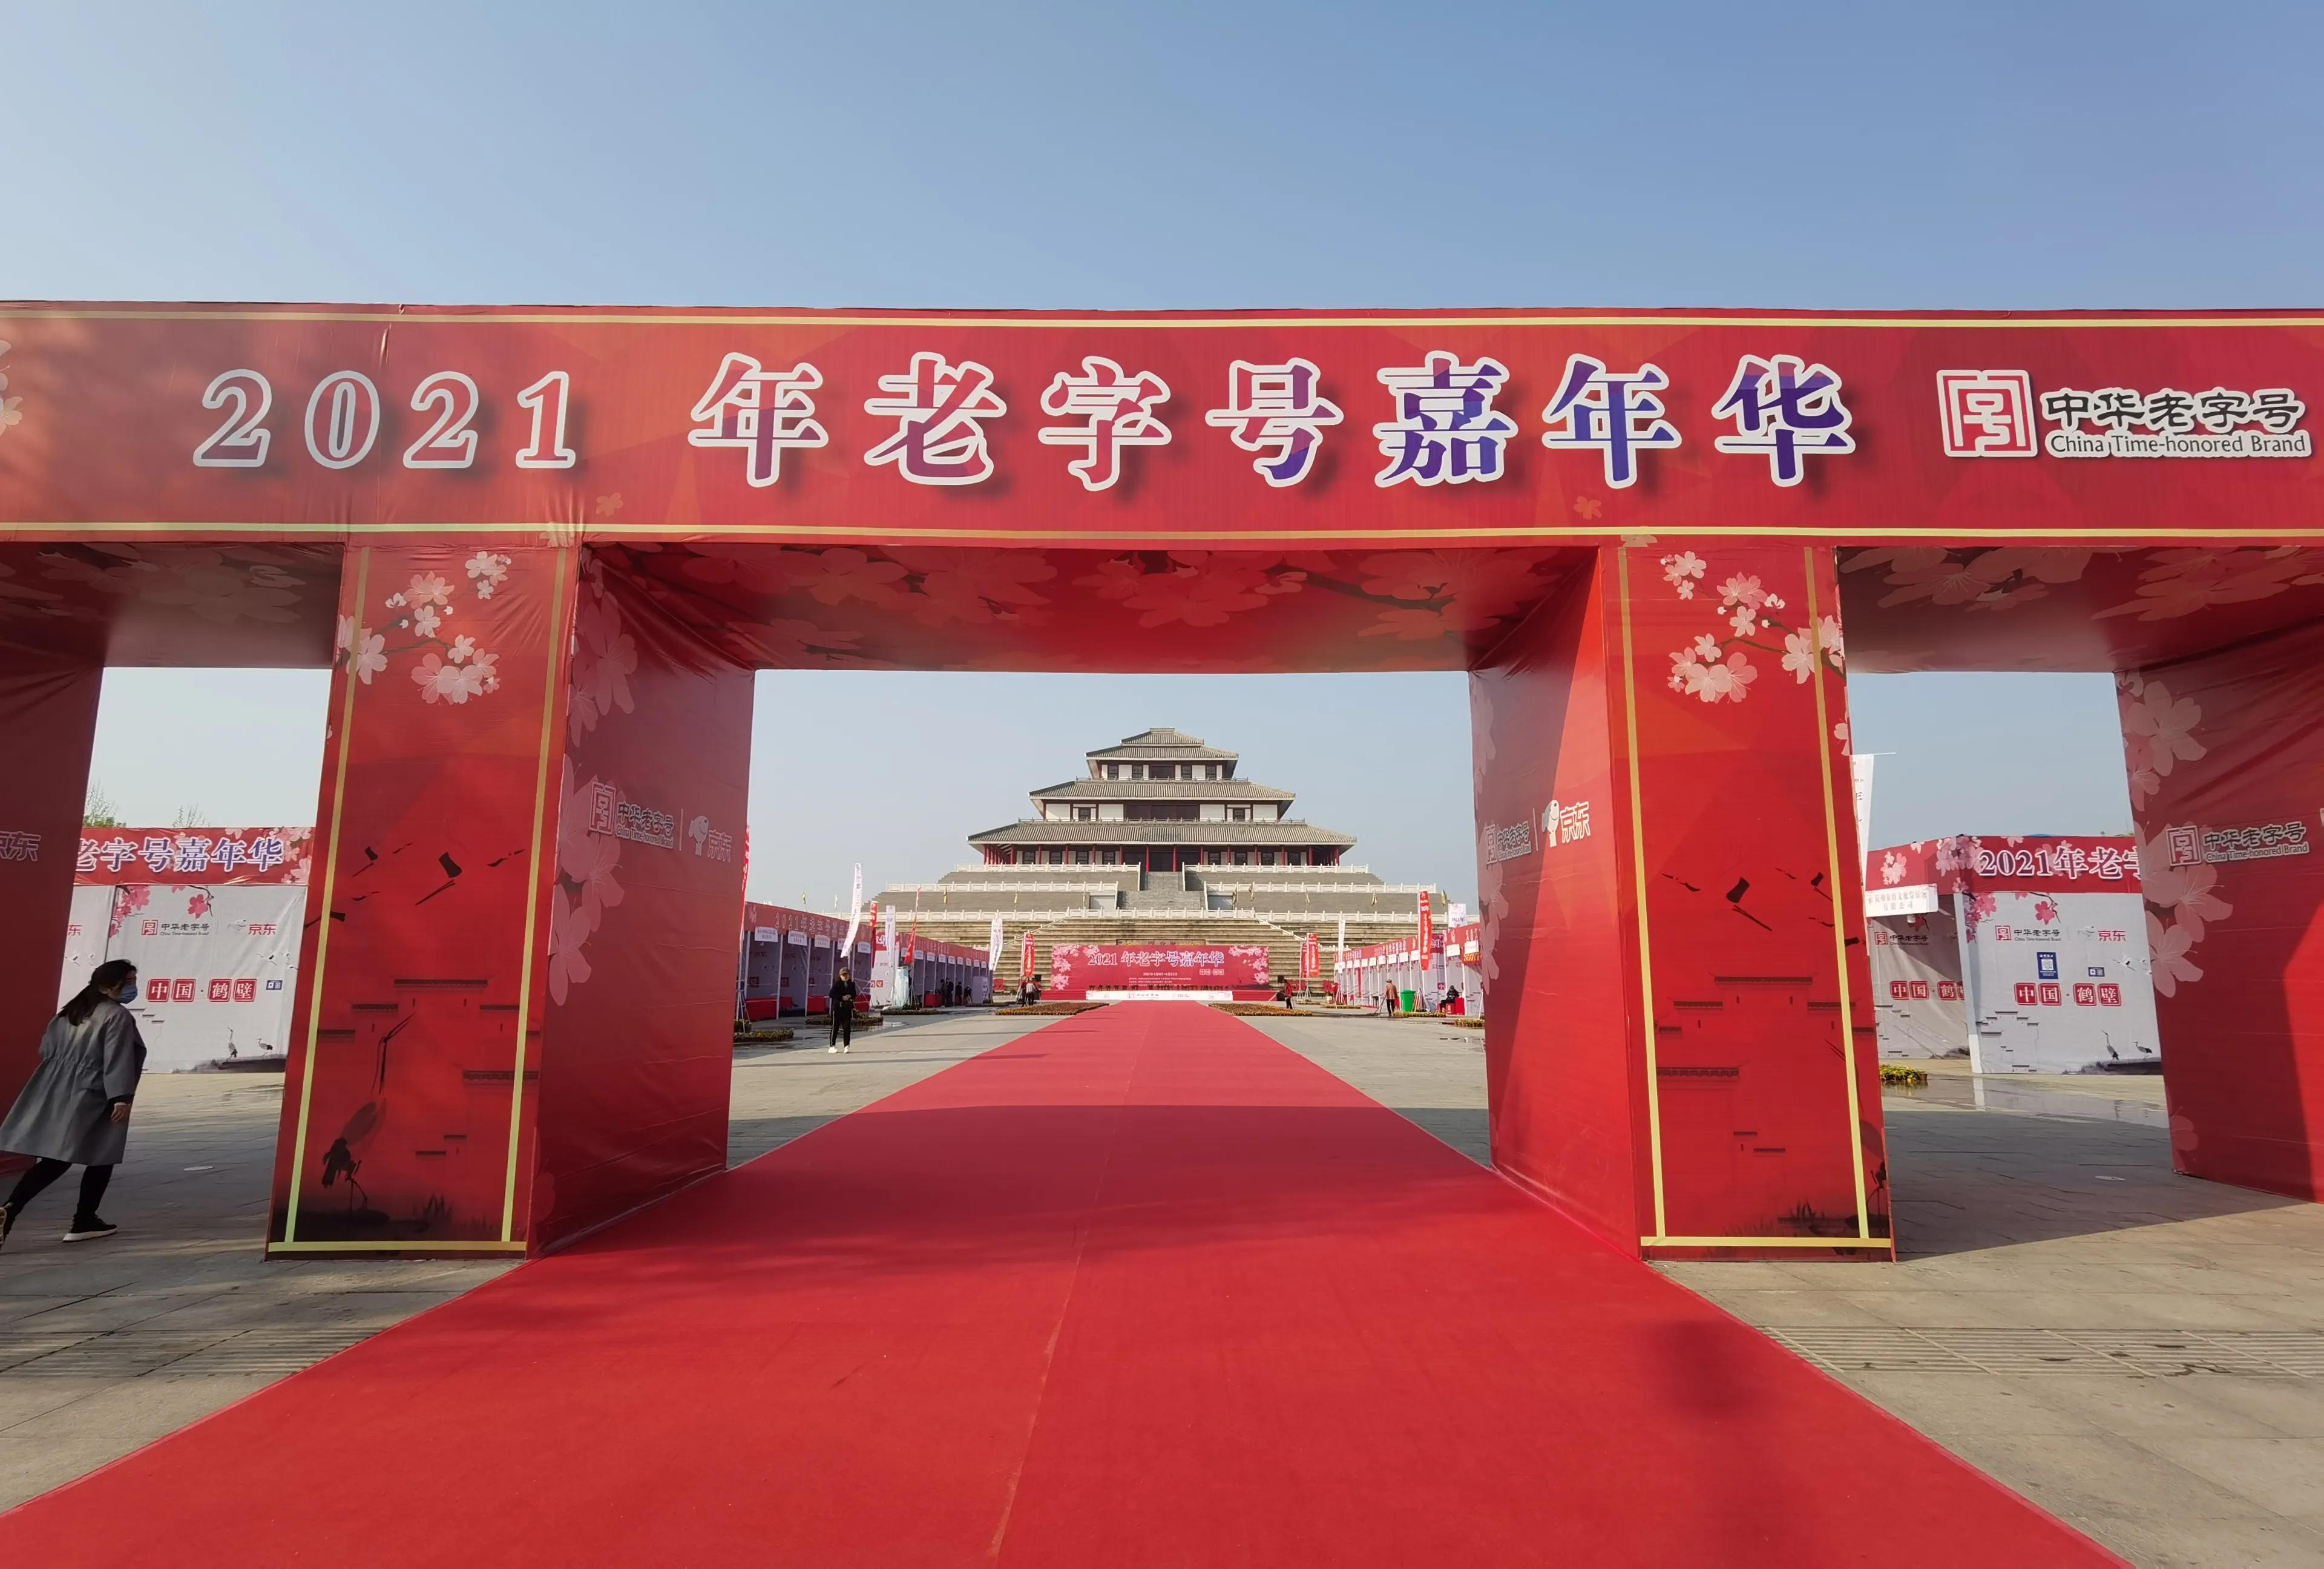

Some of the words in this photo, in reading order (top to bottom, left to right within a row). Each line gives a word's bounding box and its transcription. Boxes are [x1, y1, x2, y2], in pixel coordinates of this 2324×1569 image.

[2043, 389, 2302, 430] 中华老字号
[192, 368, 576, 469] 2021
[689, 352, 1857, 492] 年老字号嘉年华
[2050, 434, 2104, 453] China
[2112, 434, 2243, 453] Time-honored
[2251, 434, 2306, 453] Brand
[617, 801, 674, 836] 中华老字号
[1559, 801, 1591, 843] 京东
[2204, 821, 2306, 850] 中华老字号
[707, 829, 732, 863] 京东
[2205, 851, 2227, 862] China
[2228, 846, 2282, 860] Time-honored
[2284, 842, 2308, 854] Brand
[248, 924, 277, 935] 京东
[2098, 930, 2126, 942] 京东
[1088, 953, 1118, 965] 2021
[1120, 951, 1224, 967] 年老字号嘉年华
[150, 981, 254, 1000] 中国·鹤壁
[2018, 985, 2118, 1003] 中国·鹤壁
